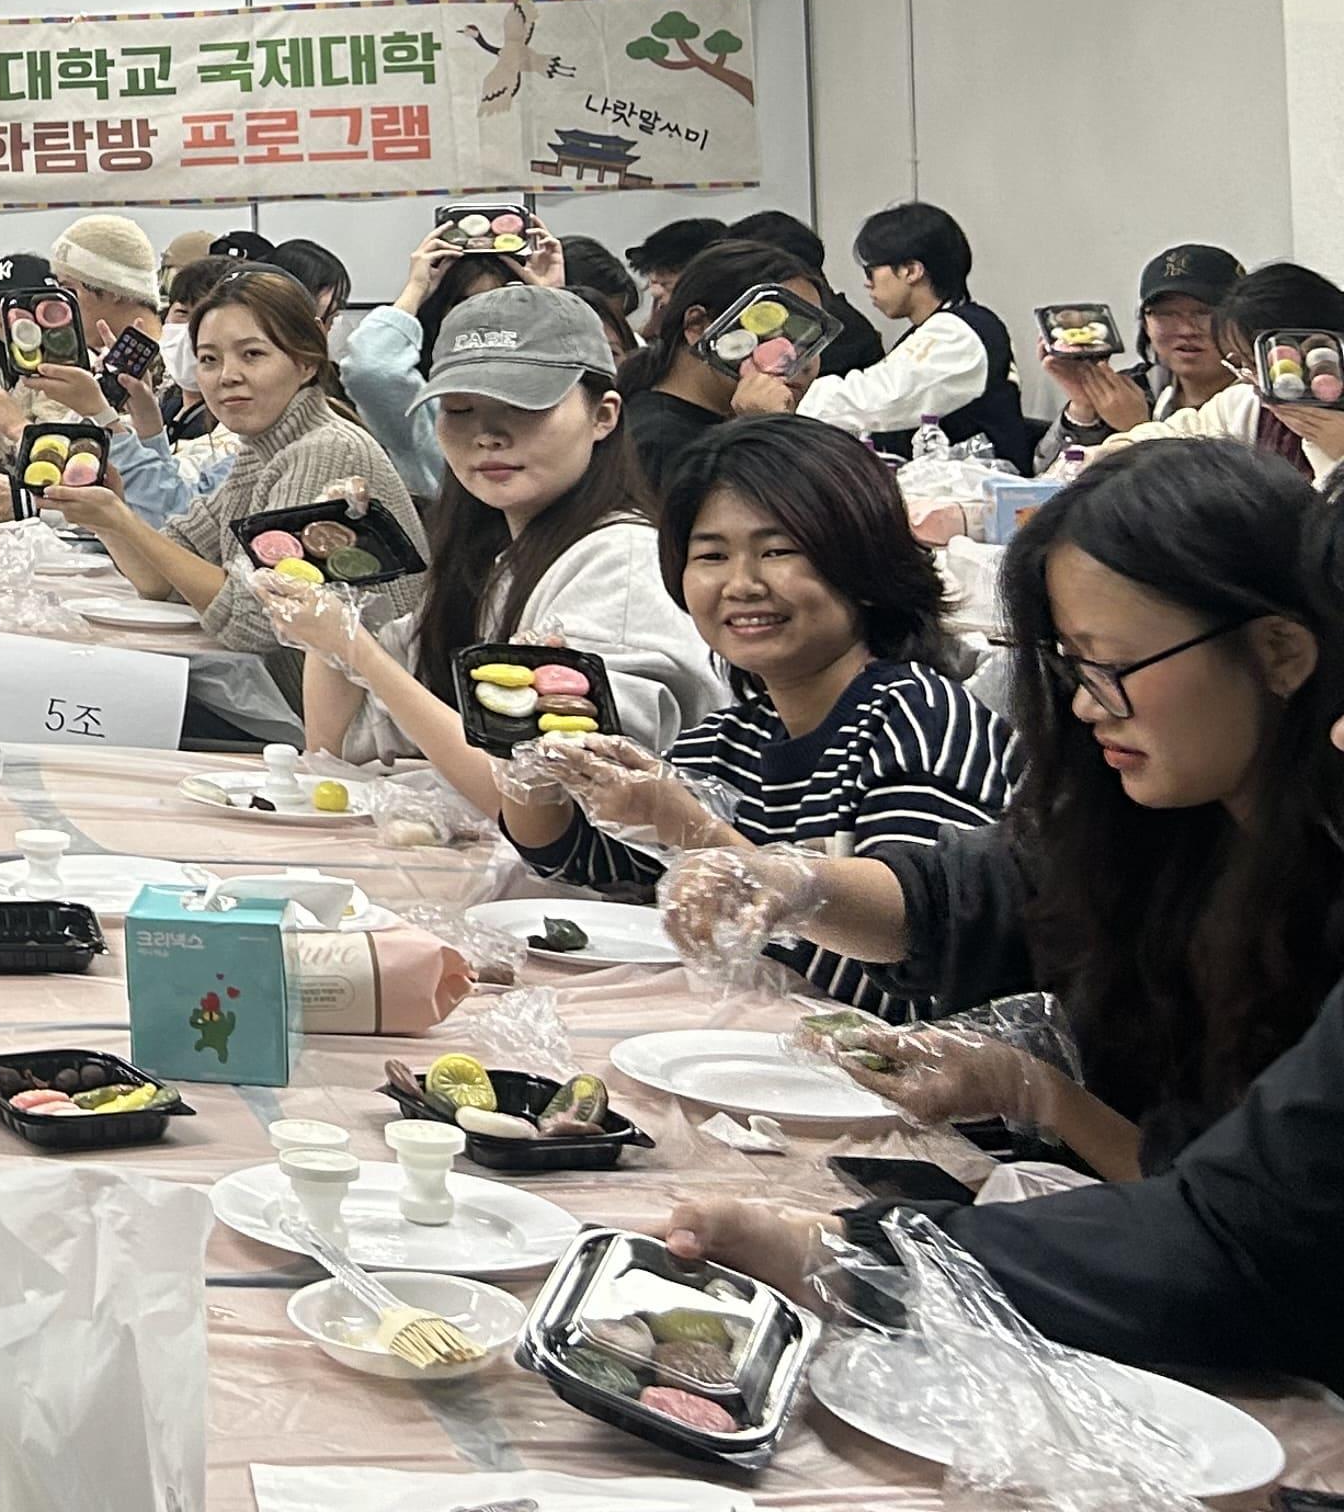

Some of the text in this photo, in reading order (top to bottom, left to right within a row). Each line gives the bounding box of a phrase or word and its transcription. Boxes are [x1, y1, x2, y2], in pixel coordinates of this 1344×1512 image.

[197, 31, 442, 92] 국제대학
[180, 104, 432, 166] 프로그램
[45, 697, 105, 738] 5조
[136, 931, 205, 950] 크리넥스
